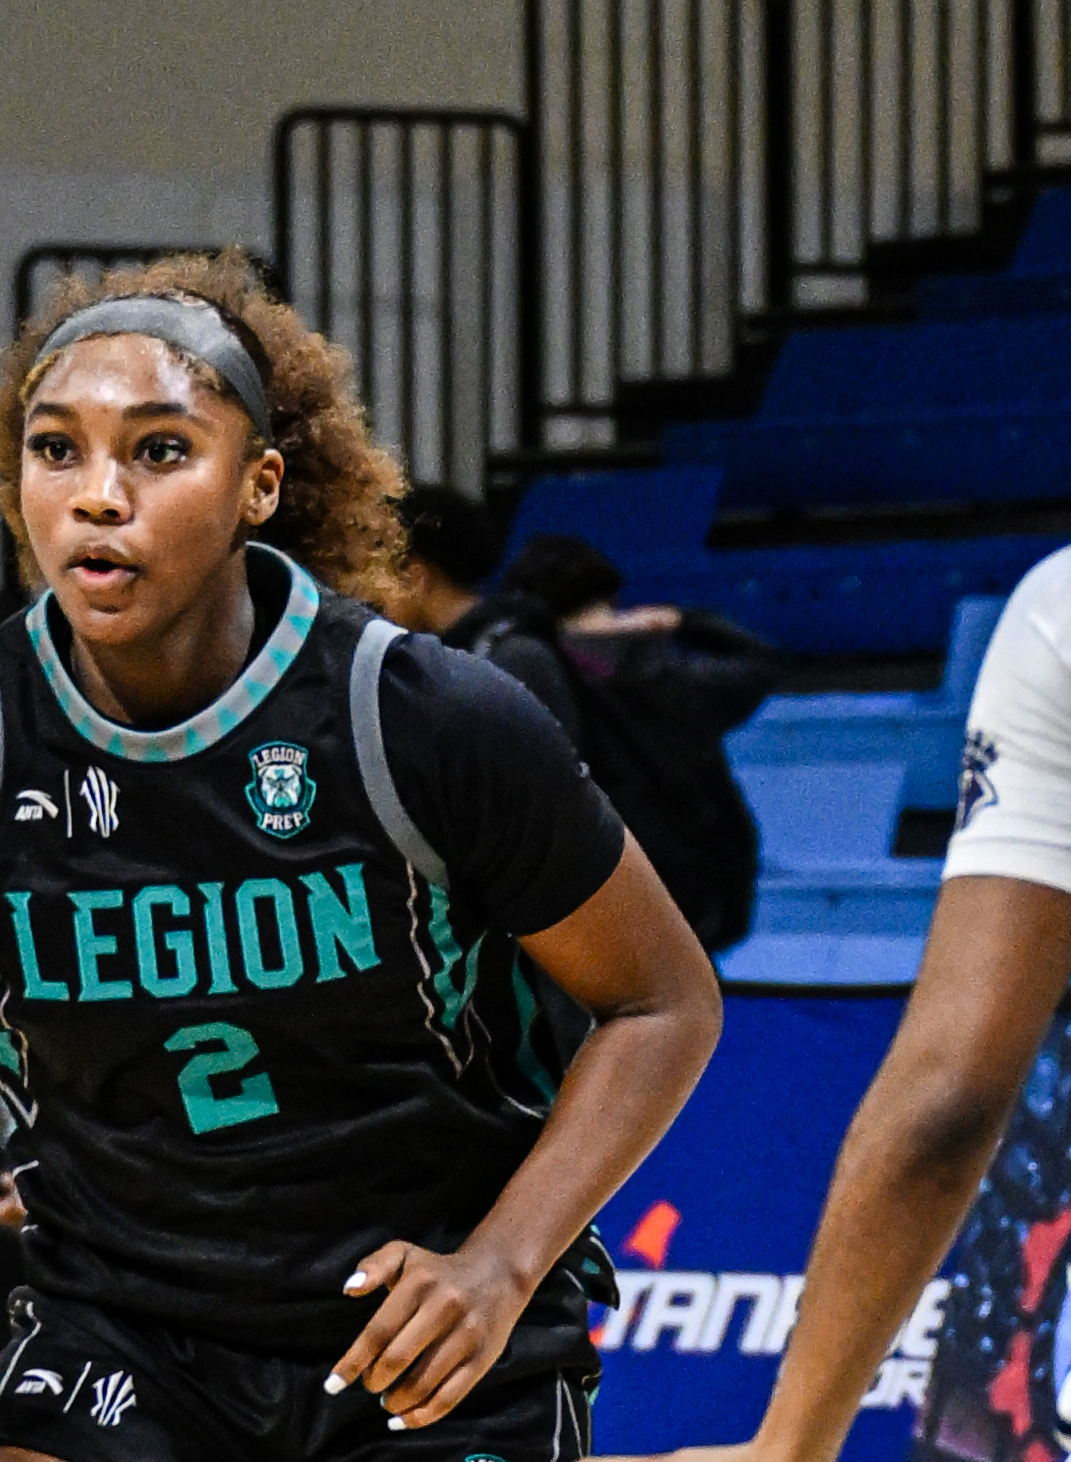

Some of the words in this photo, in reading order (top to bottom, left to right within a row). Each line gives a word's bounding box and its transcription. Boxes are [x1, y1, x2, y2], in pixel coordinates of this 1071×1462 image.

[251, 747, 307, 768] LEGION
[261, 811, 303, 830] PREP
[4, 862, 382, 1002] LEGION
[163, 1021, 280, 1135] 2
